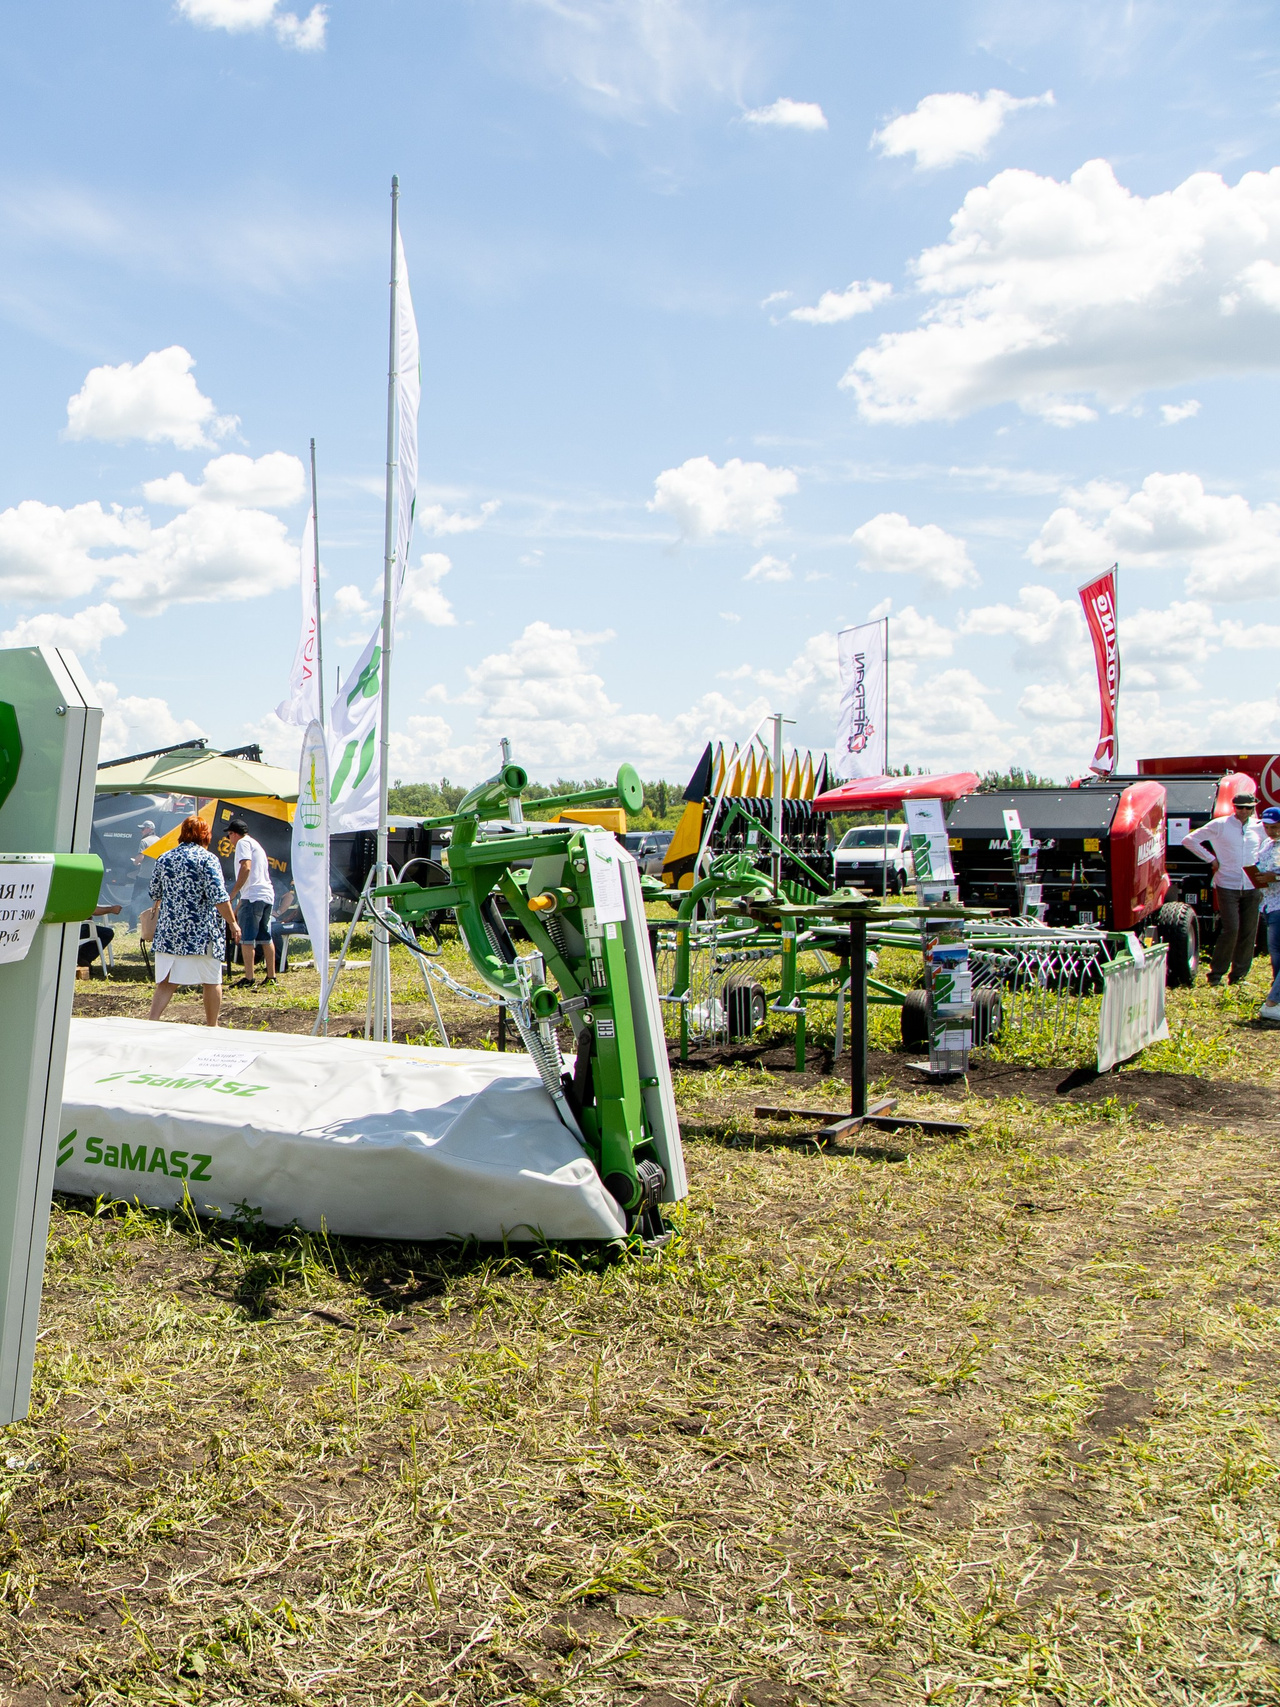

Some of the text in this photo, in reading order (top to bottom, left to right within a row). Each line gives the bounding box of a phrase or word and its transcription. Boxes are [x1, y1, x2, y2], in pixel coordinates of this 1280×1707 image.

[19, 883, 34, 900] !!!
[18, 908, 35, 921] 300
[1079, 911, 1094, 924] EAC
[127, 1073, 270, 1097] SaMASZ
[84, 1136, 213, 1182] SaMASZ
